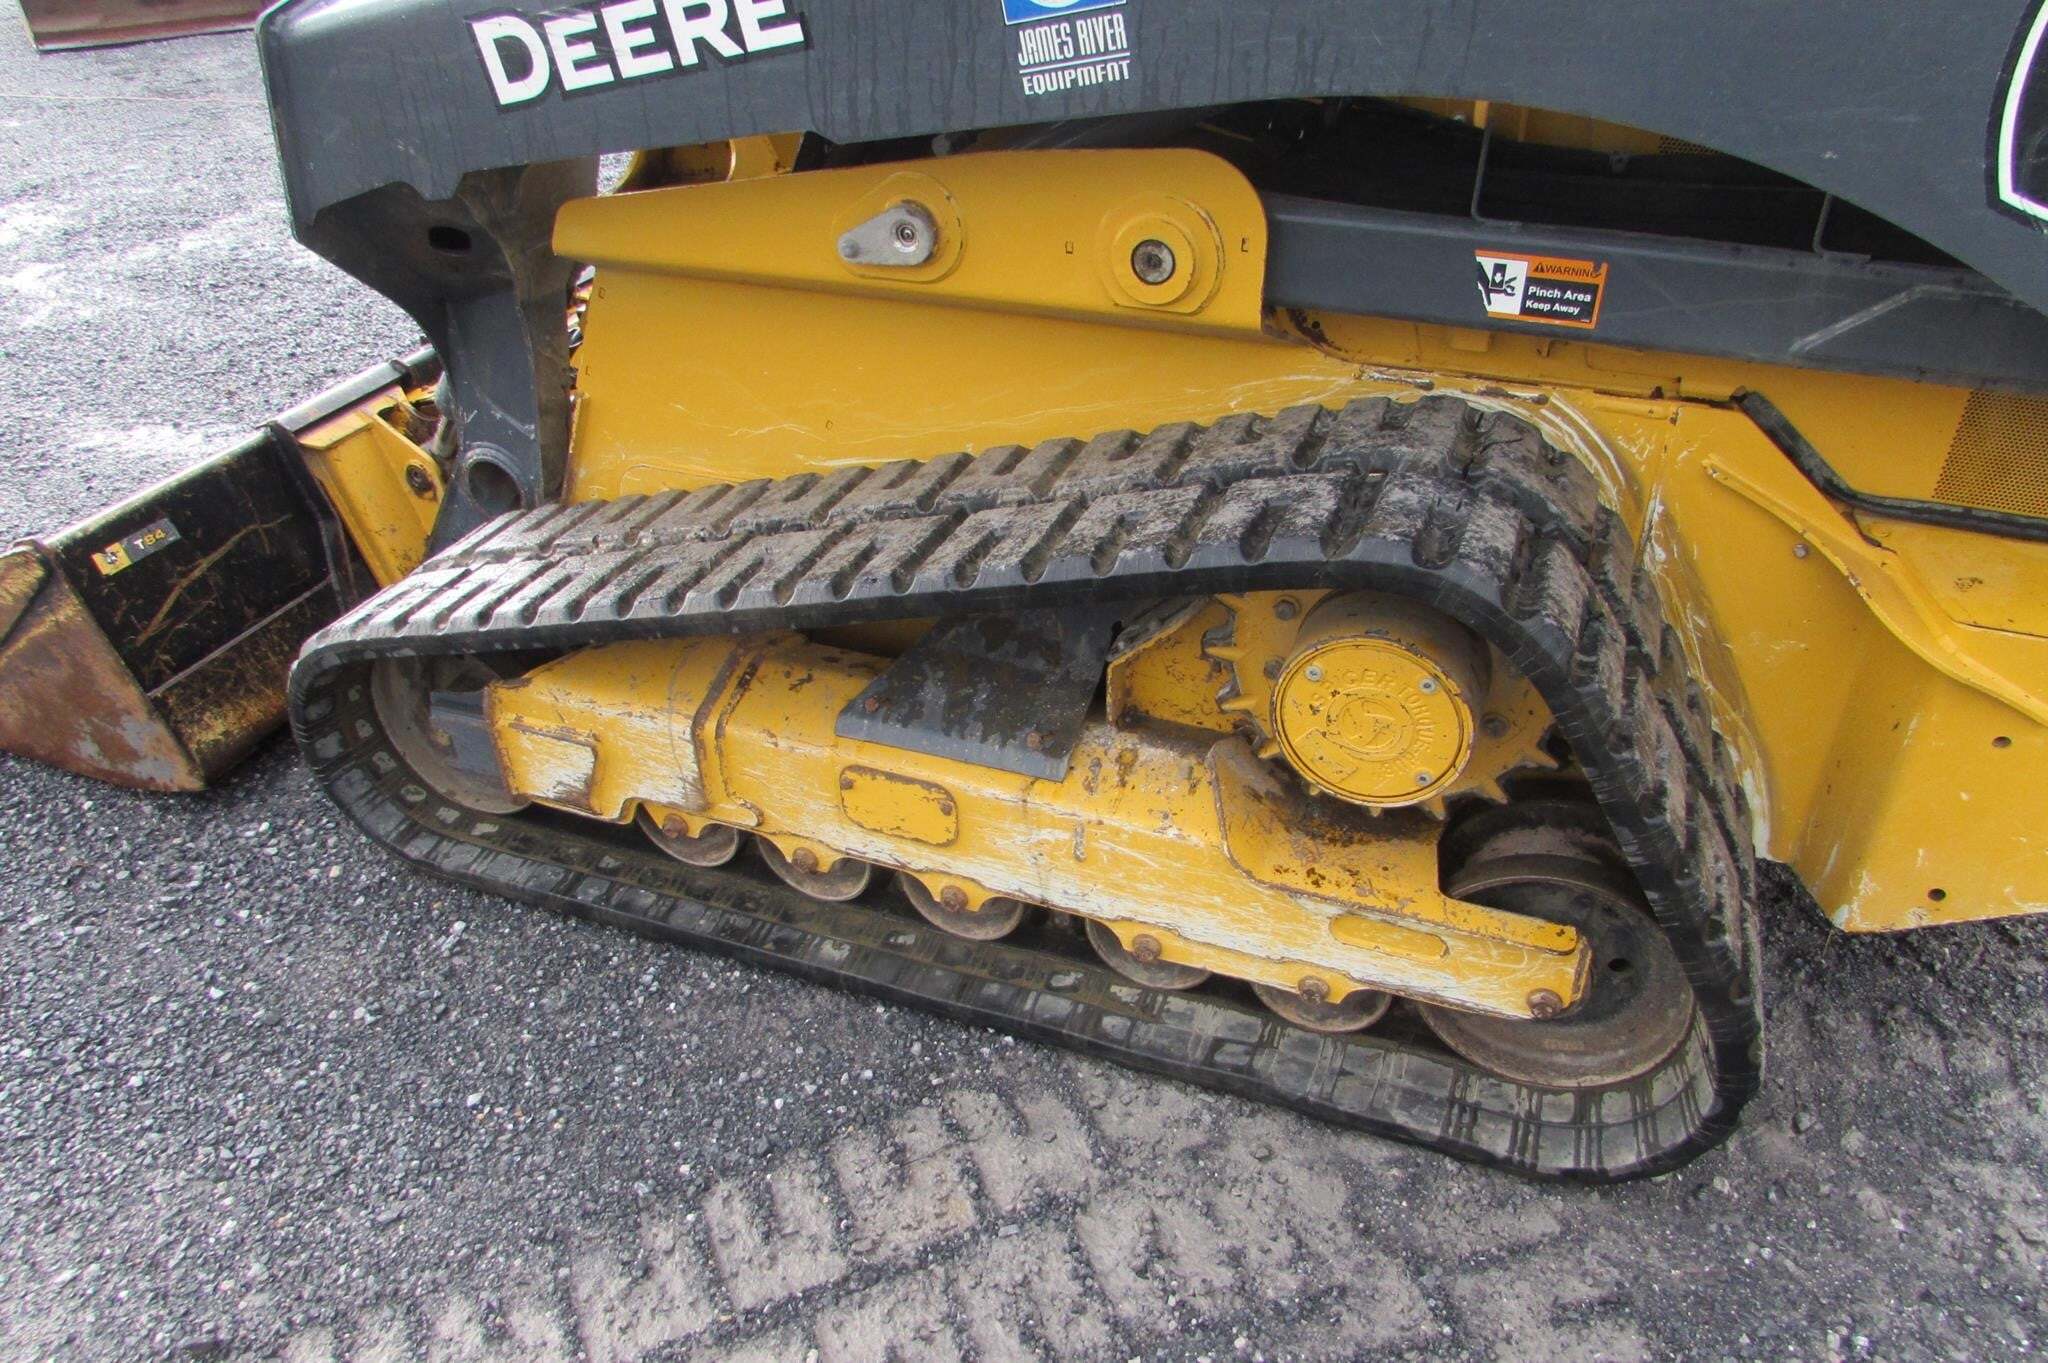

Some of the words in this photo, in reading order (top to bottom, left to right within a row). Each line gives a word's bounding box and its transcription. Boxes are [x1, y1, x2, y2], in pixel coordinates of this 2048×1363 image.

[472, 0, 804, 105] DEERE
[1018, 22, 1075, 66] JAMES
[1076, 13, 1128, 56] RIVER
[1525, 300, 1551, 312] Keep
[1552, 303, 1580, 316] Away
[1527, 286, 1561, 299] Pinch
[1563, 290, 1592, 302] Area
